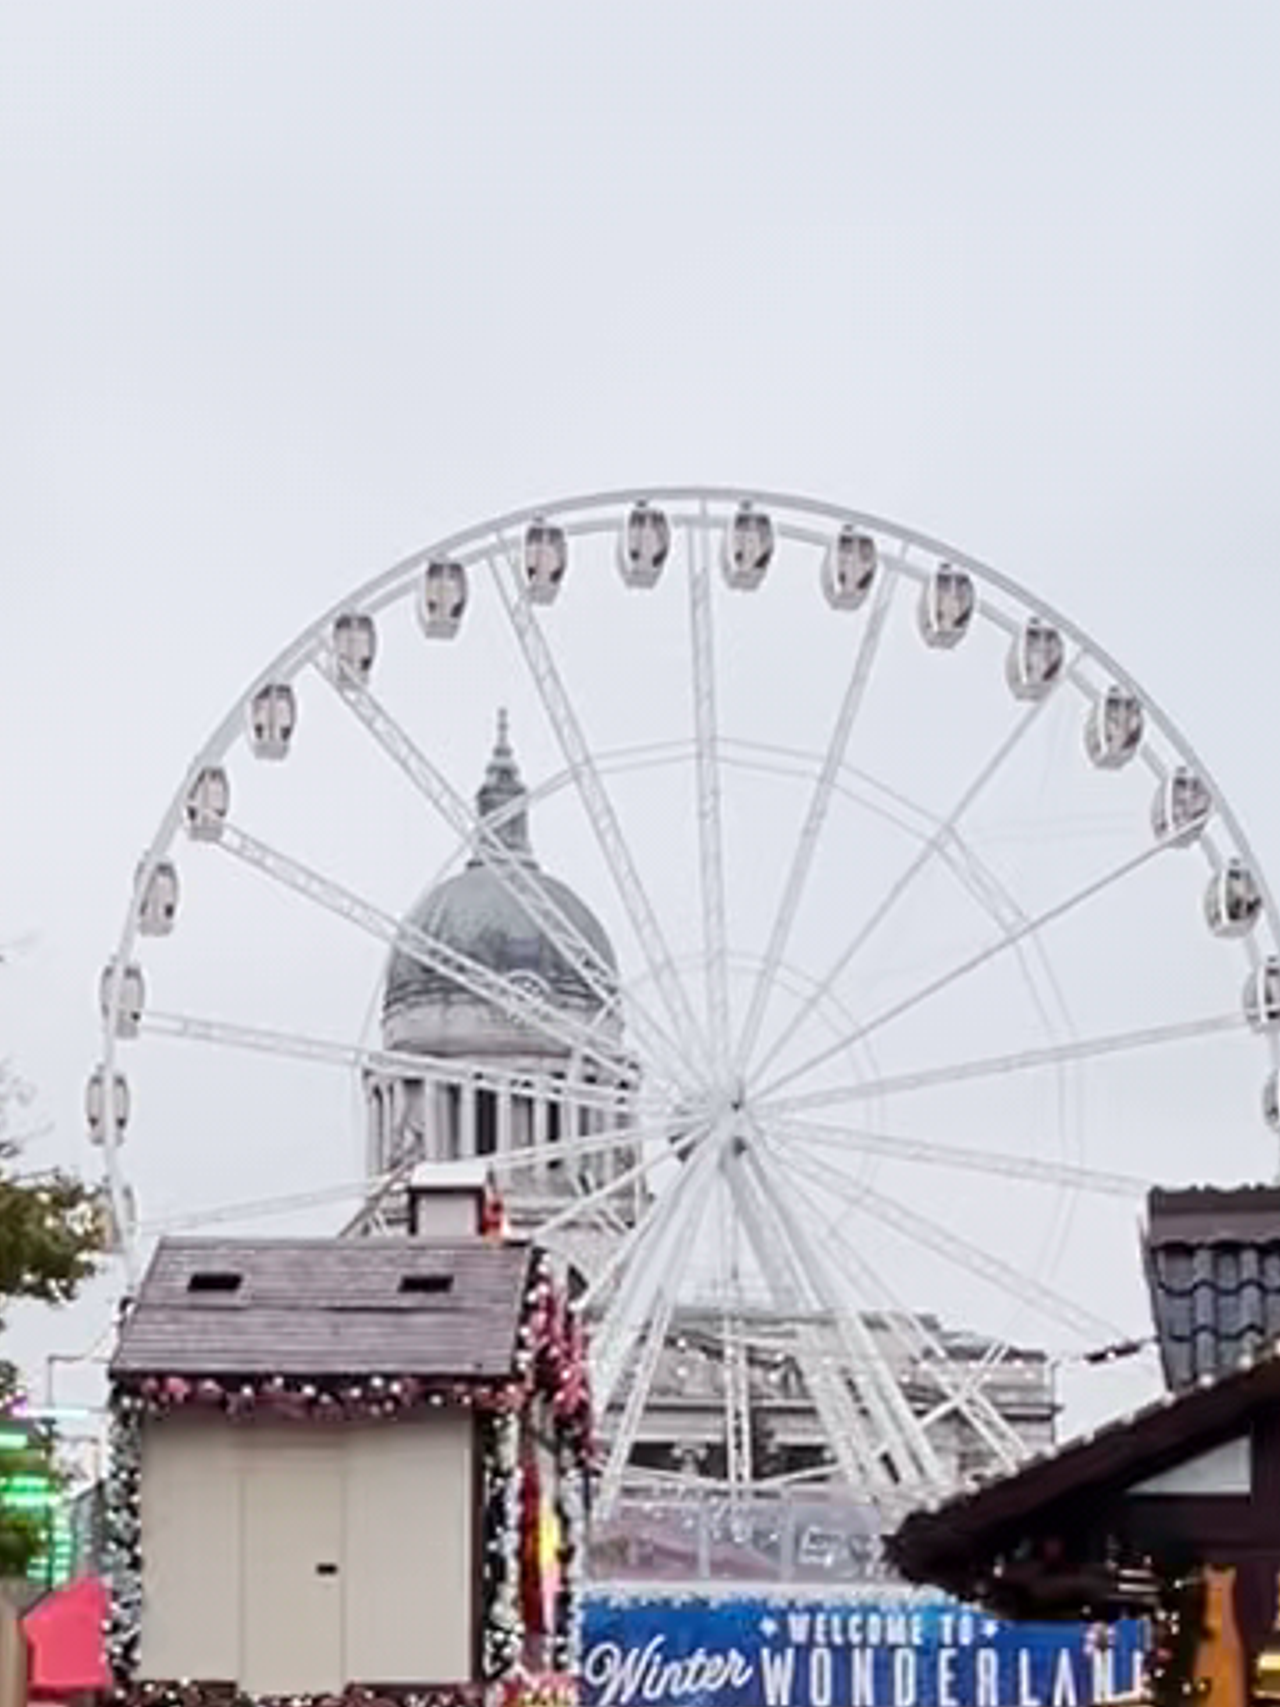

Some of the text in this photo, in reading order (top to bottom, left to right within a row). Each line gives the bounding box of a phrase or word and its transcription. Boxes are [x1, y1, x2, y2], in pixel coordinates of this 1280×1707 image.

[786, 1612, 975, 1644] WELCOME TO
[584, 1633, 754, 1707] Winter
